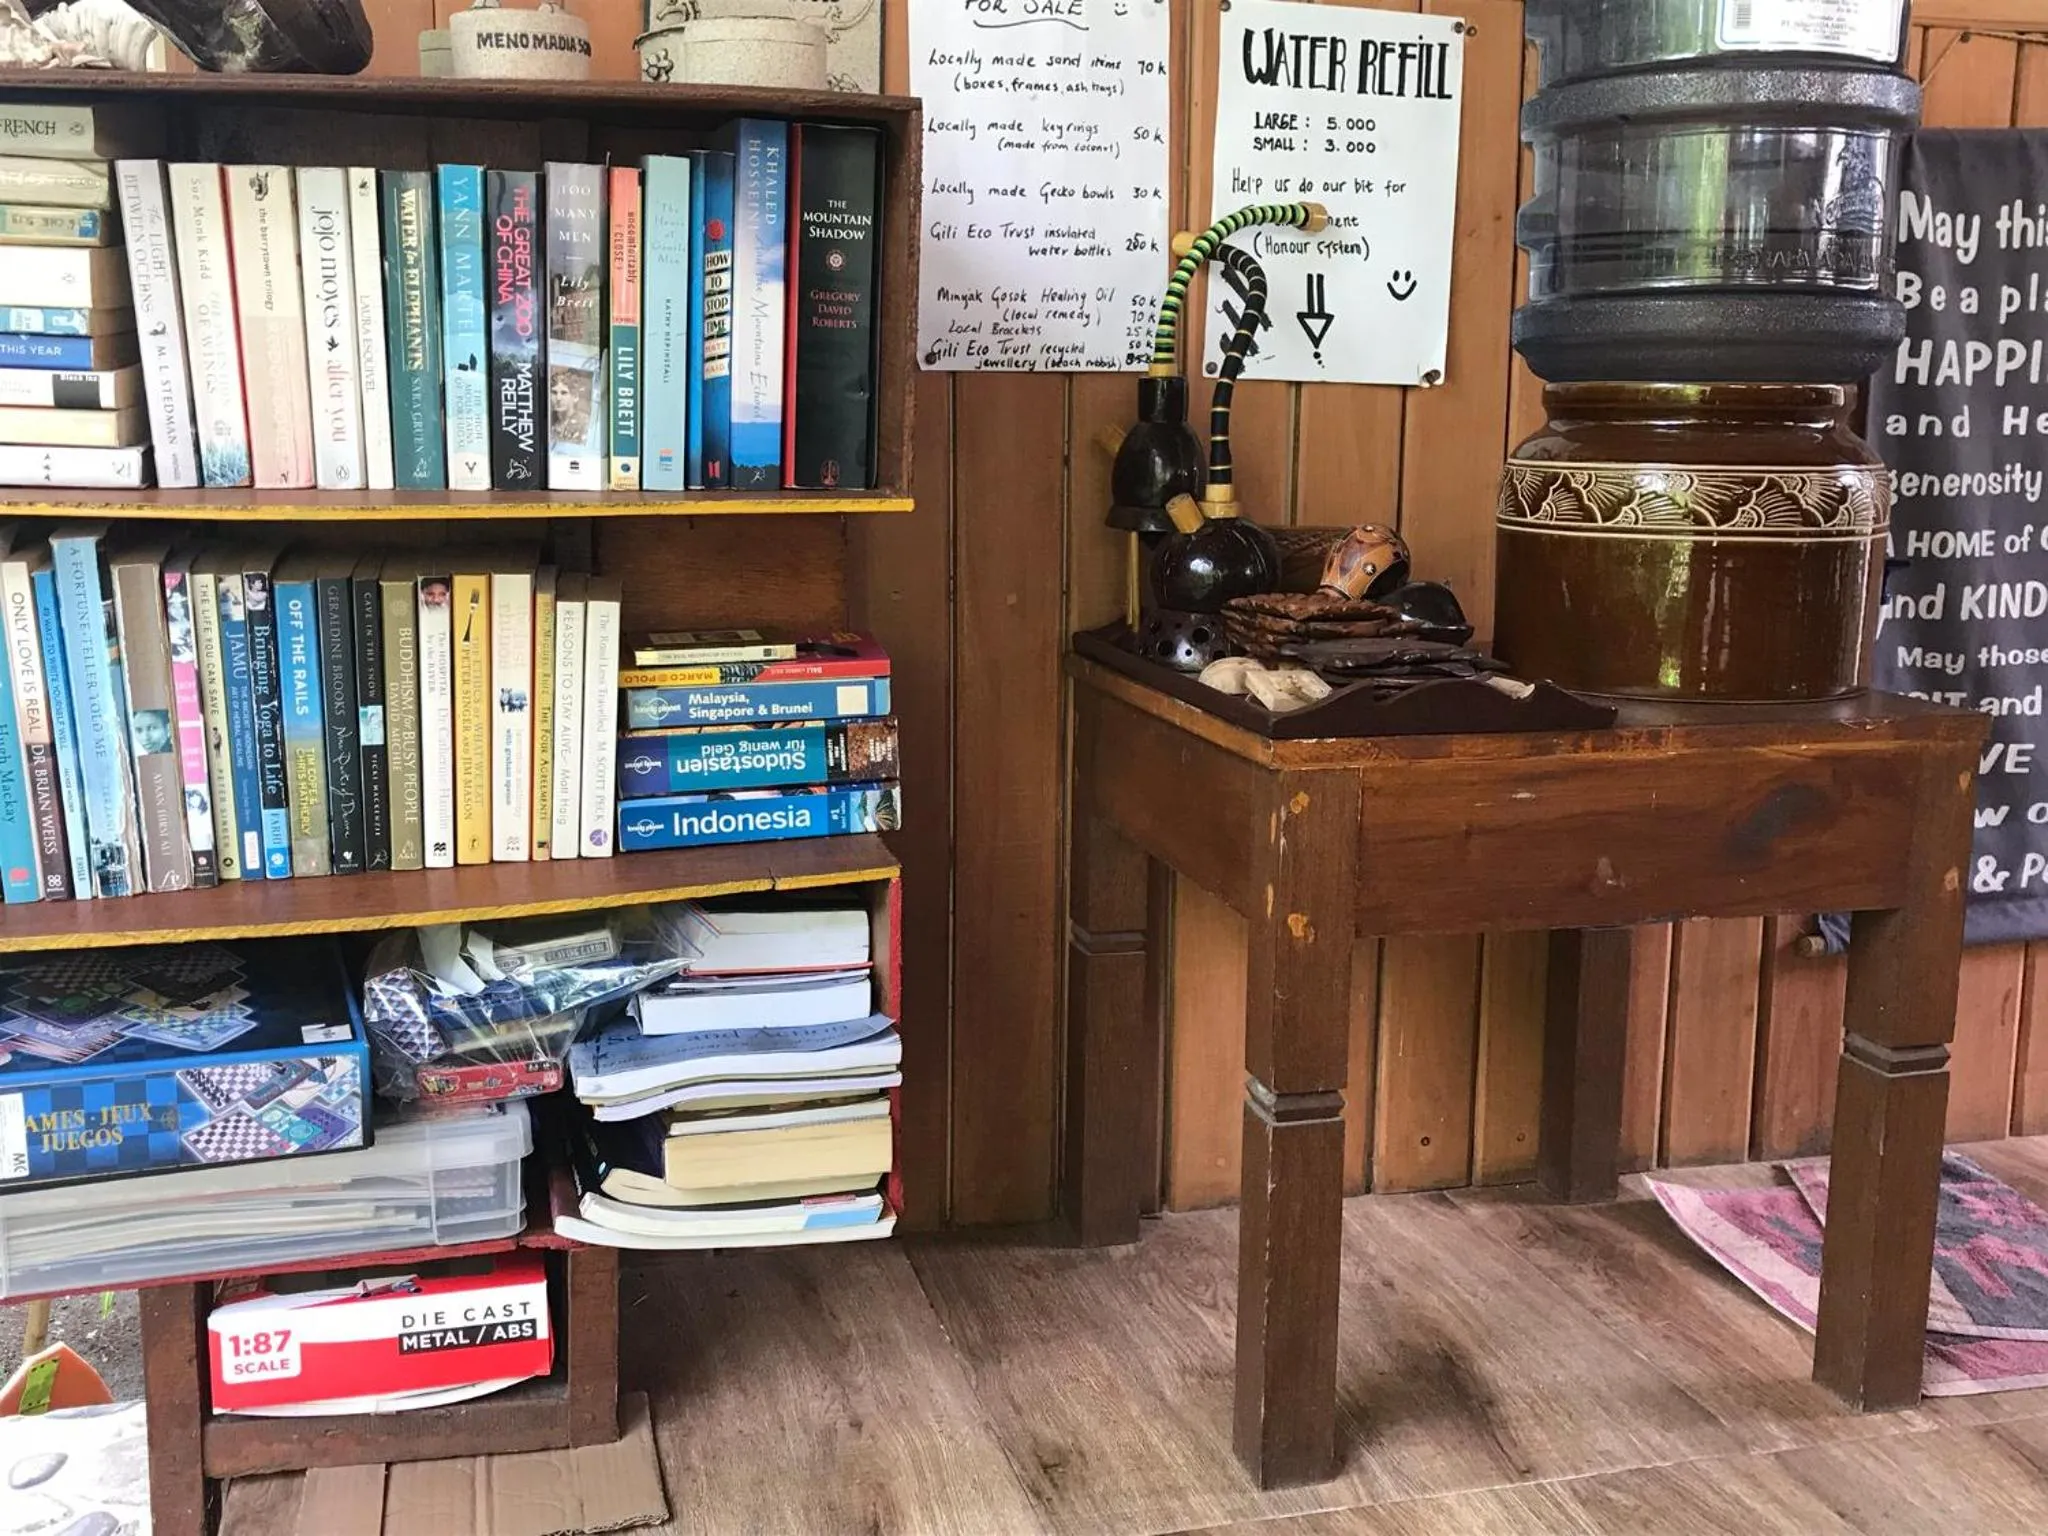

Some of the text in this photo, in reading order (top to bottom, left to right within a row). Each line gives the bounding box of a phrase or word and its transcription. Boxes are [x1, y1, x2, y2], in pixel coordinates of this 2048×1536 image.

[1023, 0, 1083, 15] SALE
[477, 32, 529, 51] MENO
[533, 34, 576, 52] MADIA
[929, 49, 982, 73] Locally
[991, 55, 1036, 67] made
[1046, 52, 1081, 69] sand
[1137, 60, 1154, 75] 70
[1242, 27, 1347, 93] WATER
[928, 117, 976, 140] Locally
[987, 120, 1024, 133] made
[1133, 126, 1149, 140] 50
[1253, 112, 1299, 131] LARGE
[1253, 137, 1296, 152] SMALL
[748, 138, 760, 231] HOSSEINI
[767, 147, 778, 225] KHALED
[932, 178, 1149, 204] Locally made Gecko bowls 30
[1232, 167, 1407, 198] Help us do our bit for
[554, 209, 595, 220] MANY
[828, 200, 846, 208] THE
[311, 207, 340, 254] jojo
[803, 212, 872, 226] MOUNTAIN
[930, 221, 1095, 239] Gili Eco Trust insulated
[1899, 190, 1981, 264] May
[560, 230, 591, 243] MEN
[809, 226, 865, 240] SHADOW
[496, 216, 514, 305] OF CHINA
[513, 187, 531, 337] THE GREAT ZOO
[707, 252, 730, 267] HOW
[1029, 242, 1111, 257] water bottles
[318, 257, 341, 329] moyes
[400, 189, 424, 371] WATER ELEPHANTS
[561, 275, 589, 291] Lily
[710, 275, 723, 289] TO
[706, 297, 729, 312] STOP
[810, 290, 861, 303] GREGORY
[937, 288, 1115, 311] Minyak Gosok Healing Oil
[812, 318, 857, 330] ROBERTS
[819, 306, 851, 316] DAVID
[30, 345, 62, 357] YEAR
[1895, 336, 2048, 387] HAPPI
[618, 346, 633, 438] LILY BRETT
[162, 380, 177, 445] STEDMAN
[500, 378, 517, 434] REILLY
[516, 362, 533, 453] MATTHEW
[326, 404, 346, 442] you
[1885, 405, 1970, 438] and
[1907, 525, 2032, 559] HOME of
[200, 584, 219, 715] THE LIFE YOU CAN SAVE
[327, 586, 345, 716] GERALDINE BROOKS
[561, 610, 574, 666] REASONS
[11, 593, 42, 733] ONLY LOVE IS REAL
[226, 630, 247, 679] JAMU
[288, 600, 309, 716] OFF THE RAILS
[1897, 645, 1965, 676] May
[562, 673, 572, 688] TO
[624, 670, 713, 684] MARCO POLO
[253, 625, 279, 794] Bringing Yoga to Life
[562, 695, 572, 719] STAY
[688, 693, 750, 706] Malaysia,
[689, 702, 813, 721] Singapore & Brunei
[1978, 685, 2042, 717] and
[390, 682, 401, 771] DAVID MICHIE
[399, 628, 417, 824] BUDDHISM for BUSY PEOPLE
[701, 744, 735, 757] Geld
[738, 740, 784, 752] wenig
[676, 752, 806, 776] Südostasien
[31, 745, 57, 855] DR BRIAN WEISS
[673, 806, 811, 836] Indonesia
[1973, 855, 2010, 892] &
[25, 1103, 153, 1132] AMES JEUX
[41, 1127, 124, 1154] JUEGOS
[402, 1302, 531, 1328] DIE CAST
[228, 1330, 292, 1357] 1:87
[402, 1329, 469, 1350] METAL
[493, 1323, 533, 1341] ABS
[234, 1359, 290, 1376] SCALE
